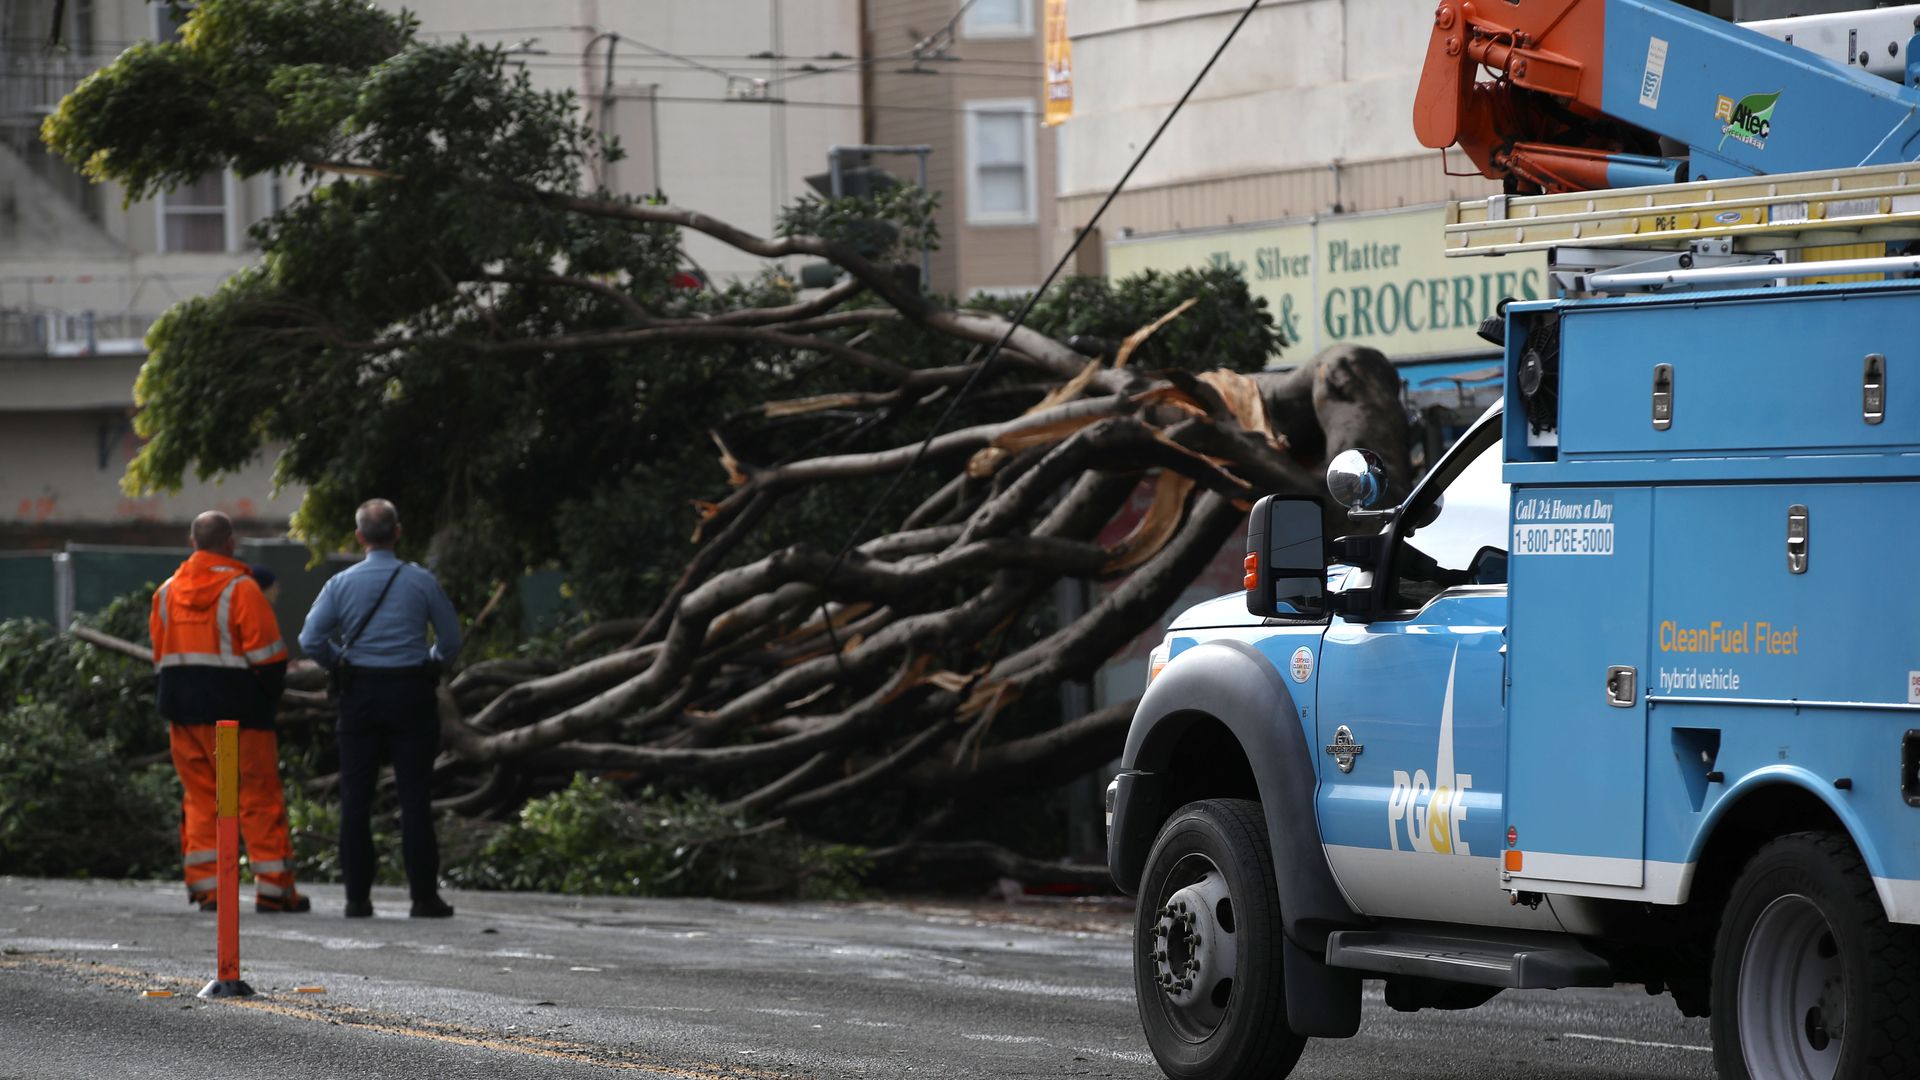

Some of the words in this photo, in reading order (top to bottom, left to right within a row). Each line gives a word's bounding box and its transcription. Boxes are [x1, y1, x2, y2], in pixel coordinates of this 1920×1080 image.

[1729, 103, 1770, 139] Altec
[1255, 246, 1310, 281] Silver
[1327, 238, 1401, 273] Platter
[1279, 292, 1302, 344] &
[1324, 267, 1540, 339] GROCERIES
[1516, 499, 1537, 520] Call
[1537, 498, 1551, 520] 24
[1551, 499, 1583, 520] Hours
[1583, 504, 1592, 520] a
[1592, 499, 1613, 523] Day
[1515, 528, 1612, 553] 1-800-PGE-5000
[1659, 620, 1750, 654] CleanFuel
[1754, 622, 1799, 655] Fleet
[1660, 667, 1697, 694] hybrid
[1699, 668, 1740, 690] vehicle
[1389, 769, 1472, 856] PG&E
